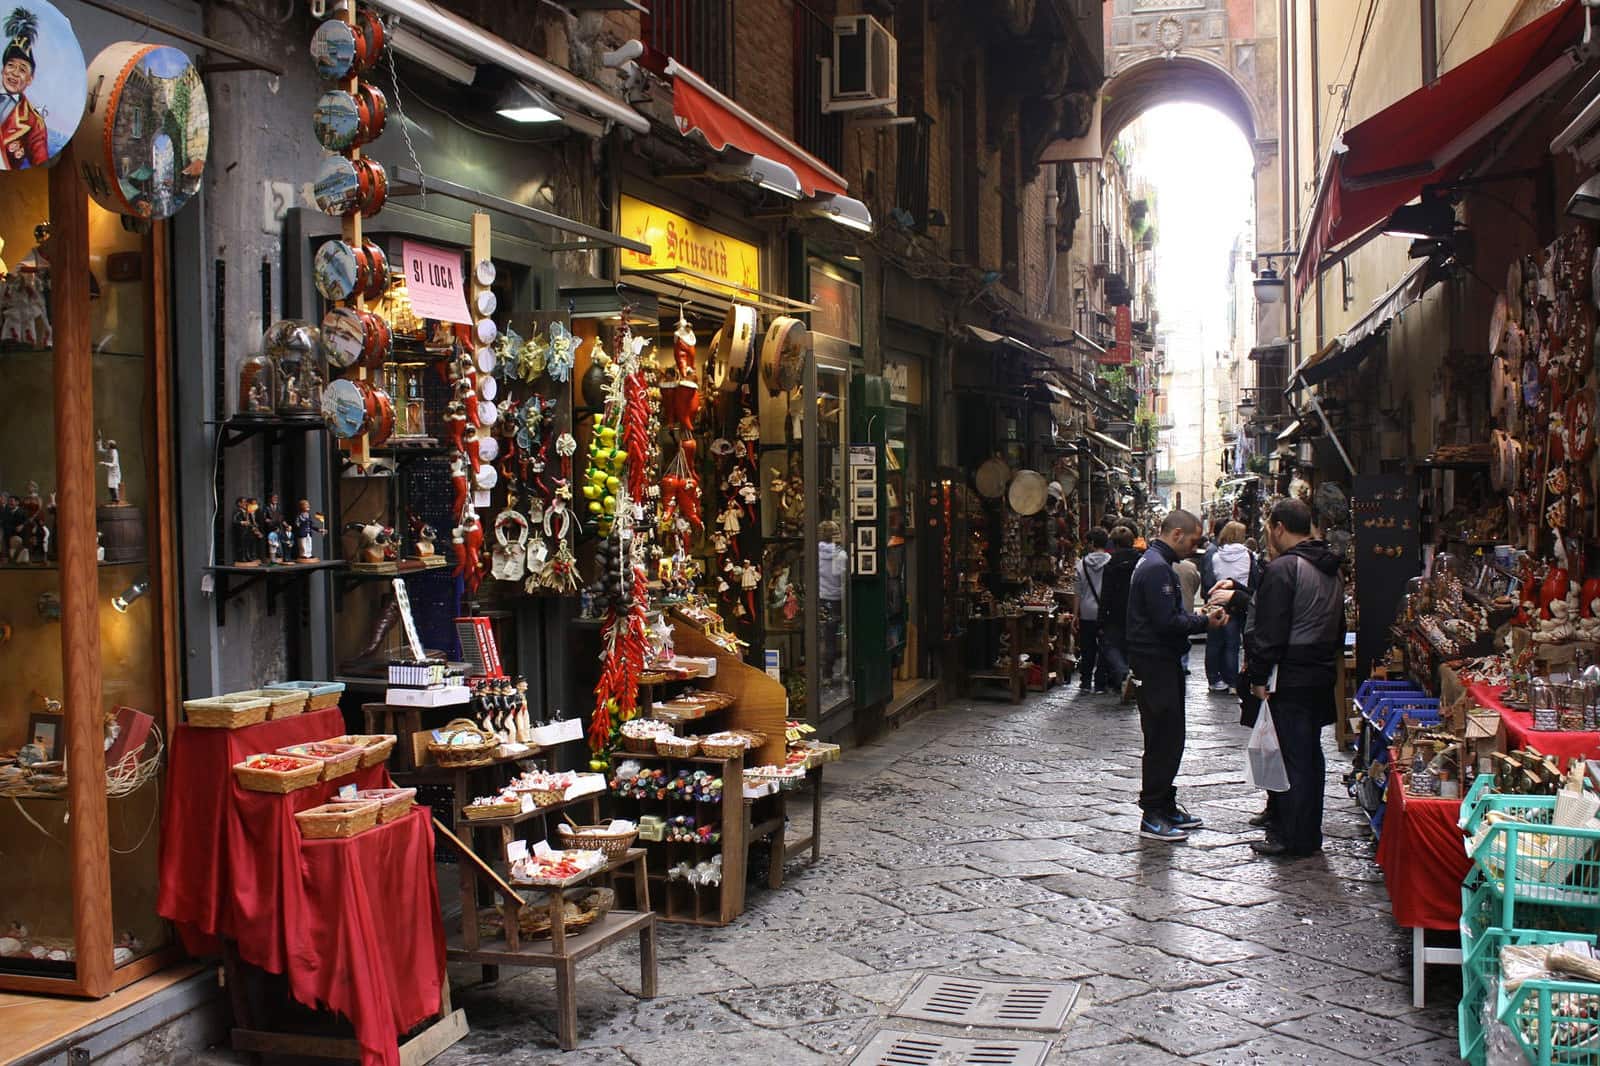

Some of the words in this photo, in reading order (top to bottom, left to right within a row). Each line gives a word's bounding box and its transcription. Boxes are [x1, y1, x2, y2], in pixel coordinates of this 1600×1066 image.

[666, 220, 728, 278] Sciuscià
[413, 259, 424, 283] SI
[428, 262, 454, 289] LOCA
